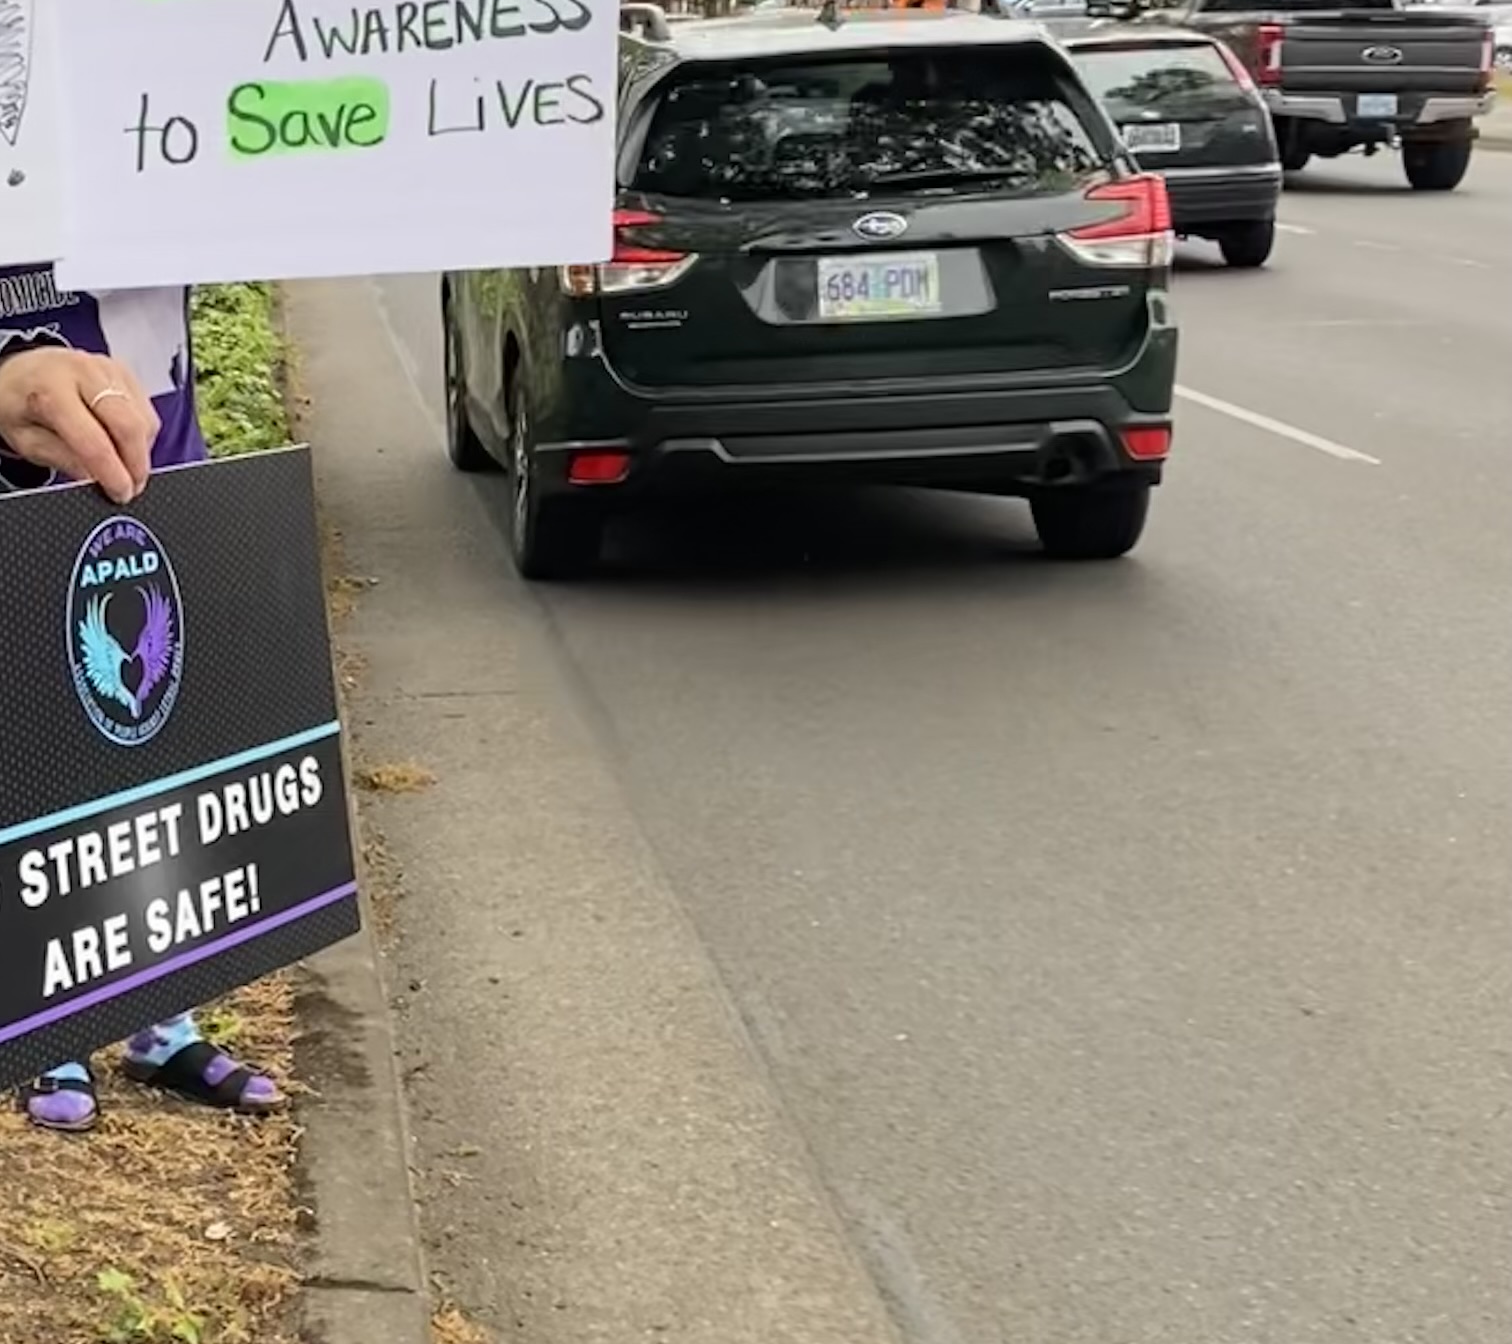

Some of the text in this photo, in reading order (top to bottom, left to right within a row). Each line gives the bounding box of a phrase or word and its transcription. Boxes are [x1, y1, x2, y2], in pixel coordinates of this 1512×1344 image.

[124, 93, 198, 172] to
[228, 83, 384, 154] Save
[827, 270, 869, 301] 684
[80, 549, 159, 588] APALD
[19, 803, 182, 908] STREET
[197, 756, 322, 845] DRUGS
[43, 863, 260, 997] ARE SAFE!
